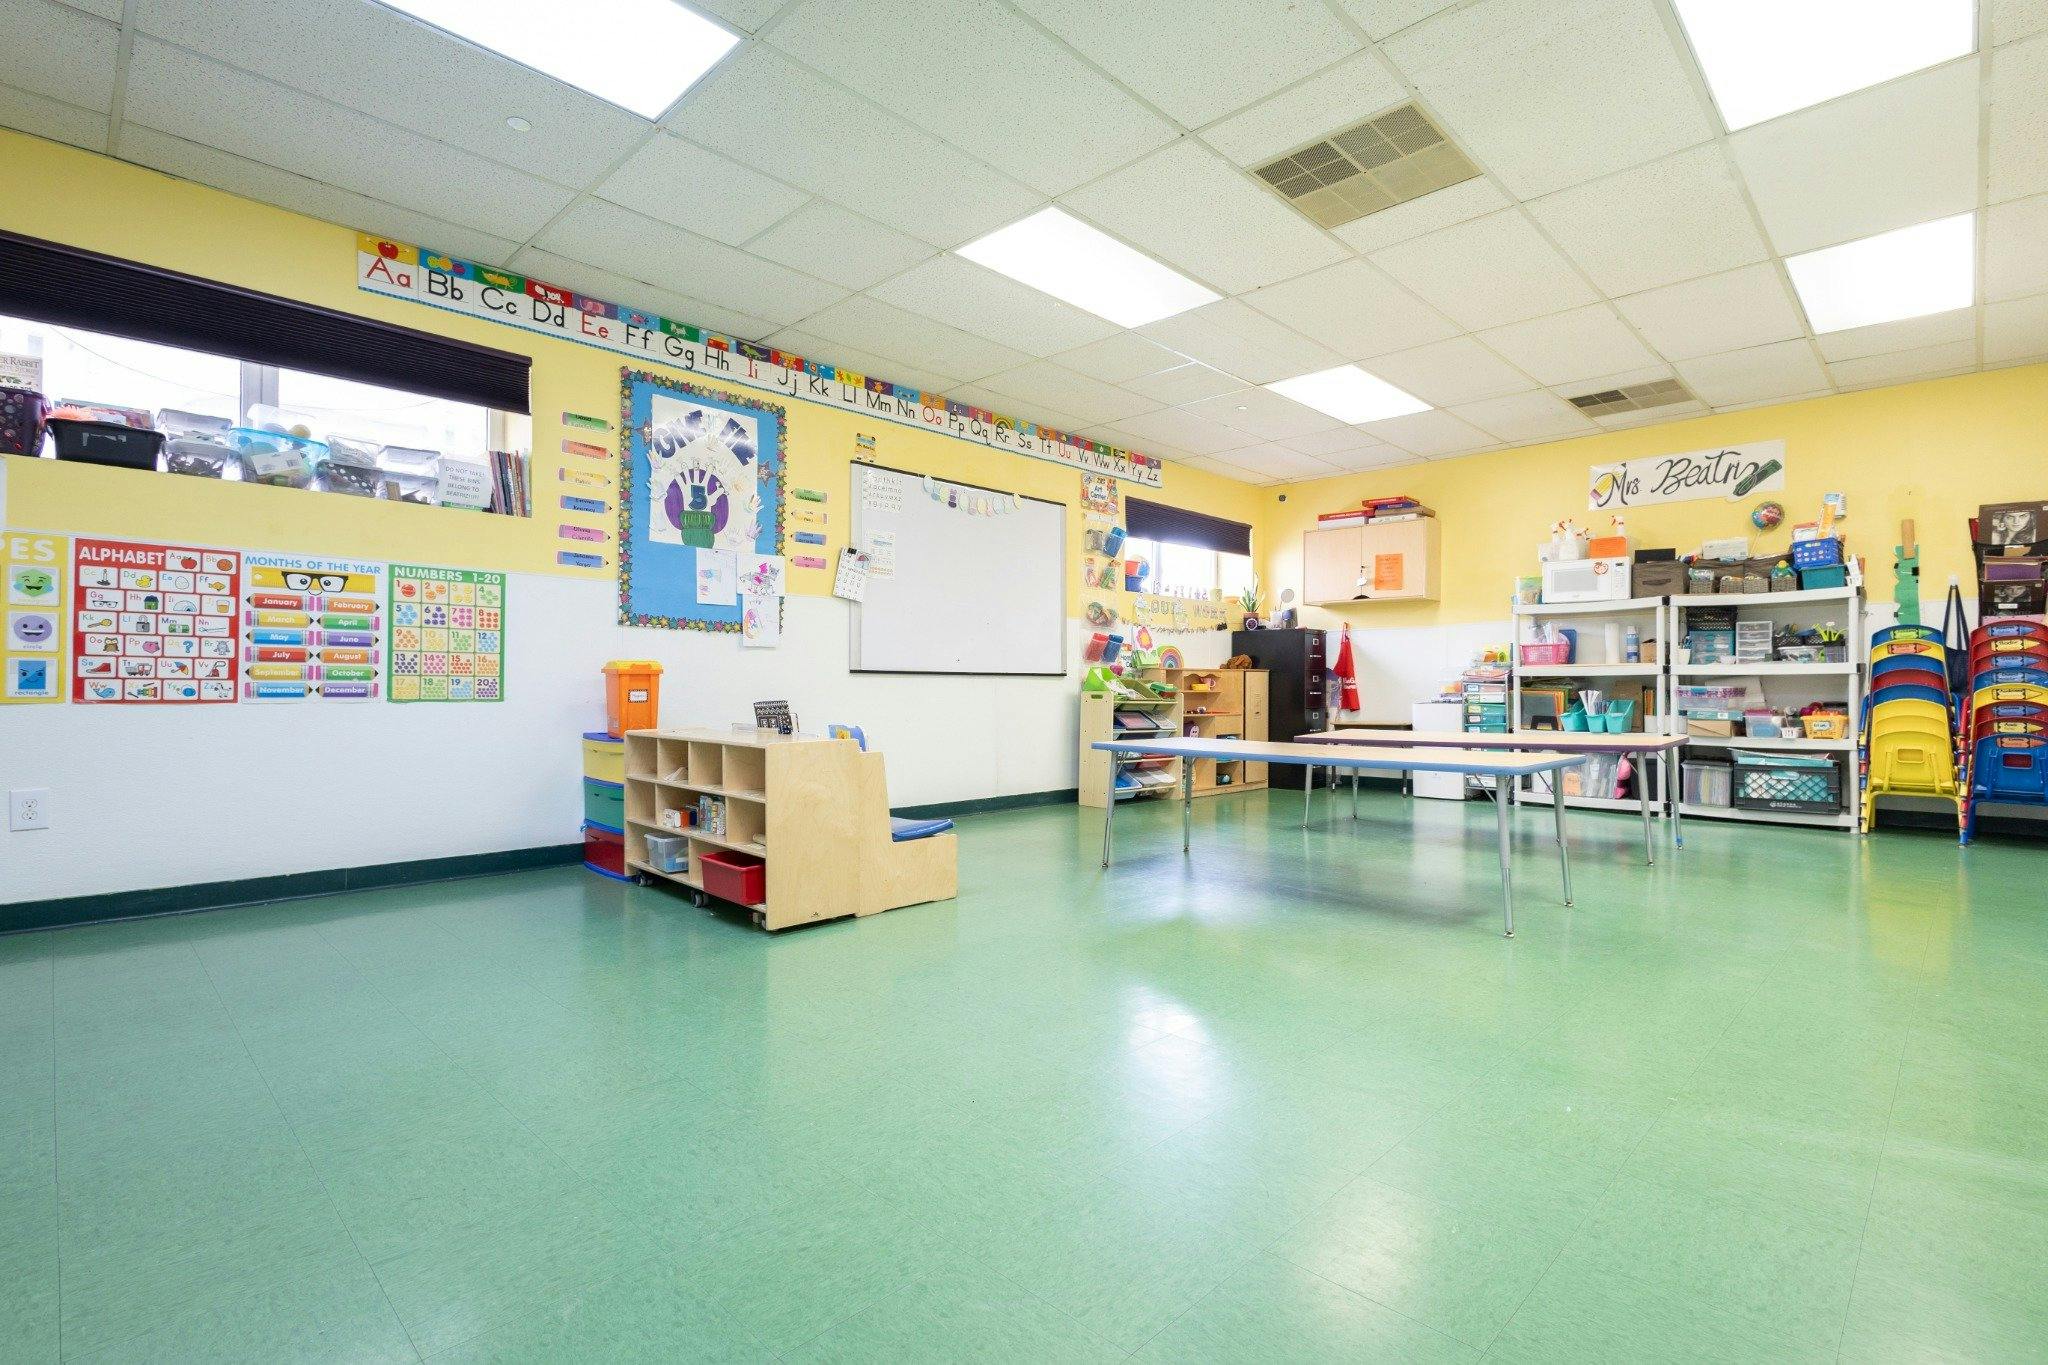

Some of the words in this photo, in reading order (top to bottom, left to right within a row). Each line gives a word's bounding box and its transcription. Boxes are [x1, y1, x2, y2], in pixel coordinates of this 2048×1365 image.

[10, 356, 39, 368] RABBIT
[366, 257, 411, 288] Aa
[428, 269, 463, 300] Bb
[481, 287, 517, 314] Cc
[533, 299, 565, 327] Dd
[581, 311, 609, 338] Ee
[626, 324, 653, 349] Ff
[664, 336, 695, 370] Gg
[705, 346, 730, 371] Hh
[748, 358, 758, 379] Ii
[778, 369, 797, 397] Jj
[810, 374, 829, 396] Kk
[843, 384, 856, 404] Ll
[867, 392, 891, 413] Mm
[897, 399, 915, 419] Nn
[923, 406, 942, 425] Oo
[949, 412, 965, 438] Pp
[970, 419, 991, 445] Qq
[996, 426, 1010, 443] Rr
[1019, 433, 1032, 449] Ss
[1041, 438, 1051, 454] Tt
[1059, 442, 1071, 458] Uu
[1079, 451, 1089, 463] Vv
[1094, 454, 1110, 469] Ww
[1114, 459, 1126, 473] Xx
[1131, 464, 1142, 483] Yy
[1147, 466, 1158, 482] Zz
[1651, 450, 1760, 497] Beatriz
[448, 483, 470, 491] BELONG
[689, 485, 707, 510] 5
[79, 546, 165, 565] ALPHABET
[245, 556, 302, 568] MONTHS
[307, 560, 323, 569] OF
[327, 562, 349, 572] THE
[354, 565, 380, 574] YEAR
[394, 566, 463, 581] NUMBERS
[472, 573, 500, 584] 1-20
[90, 591, 104, 600] Gg
[262, 598, 298, 607] January
[333, 602, 369, 610] February
[267, 616, 294, 624] March
[270, 634, 289, 642] May
[334, 653, 361, 661] August
[255, 668, 298, 677] September
